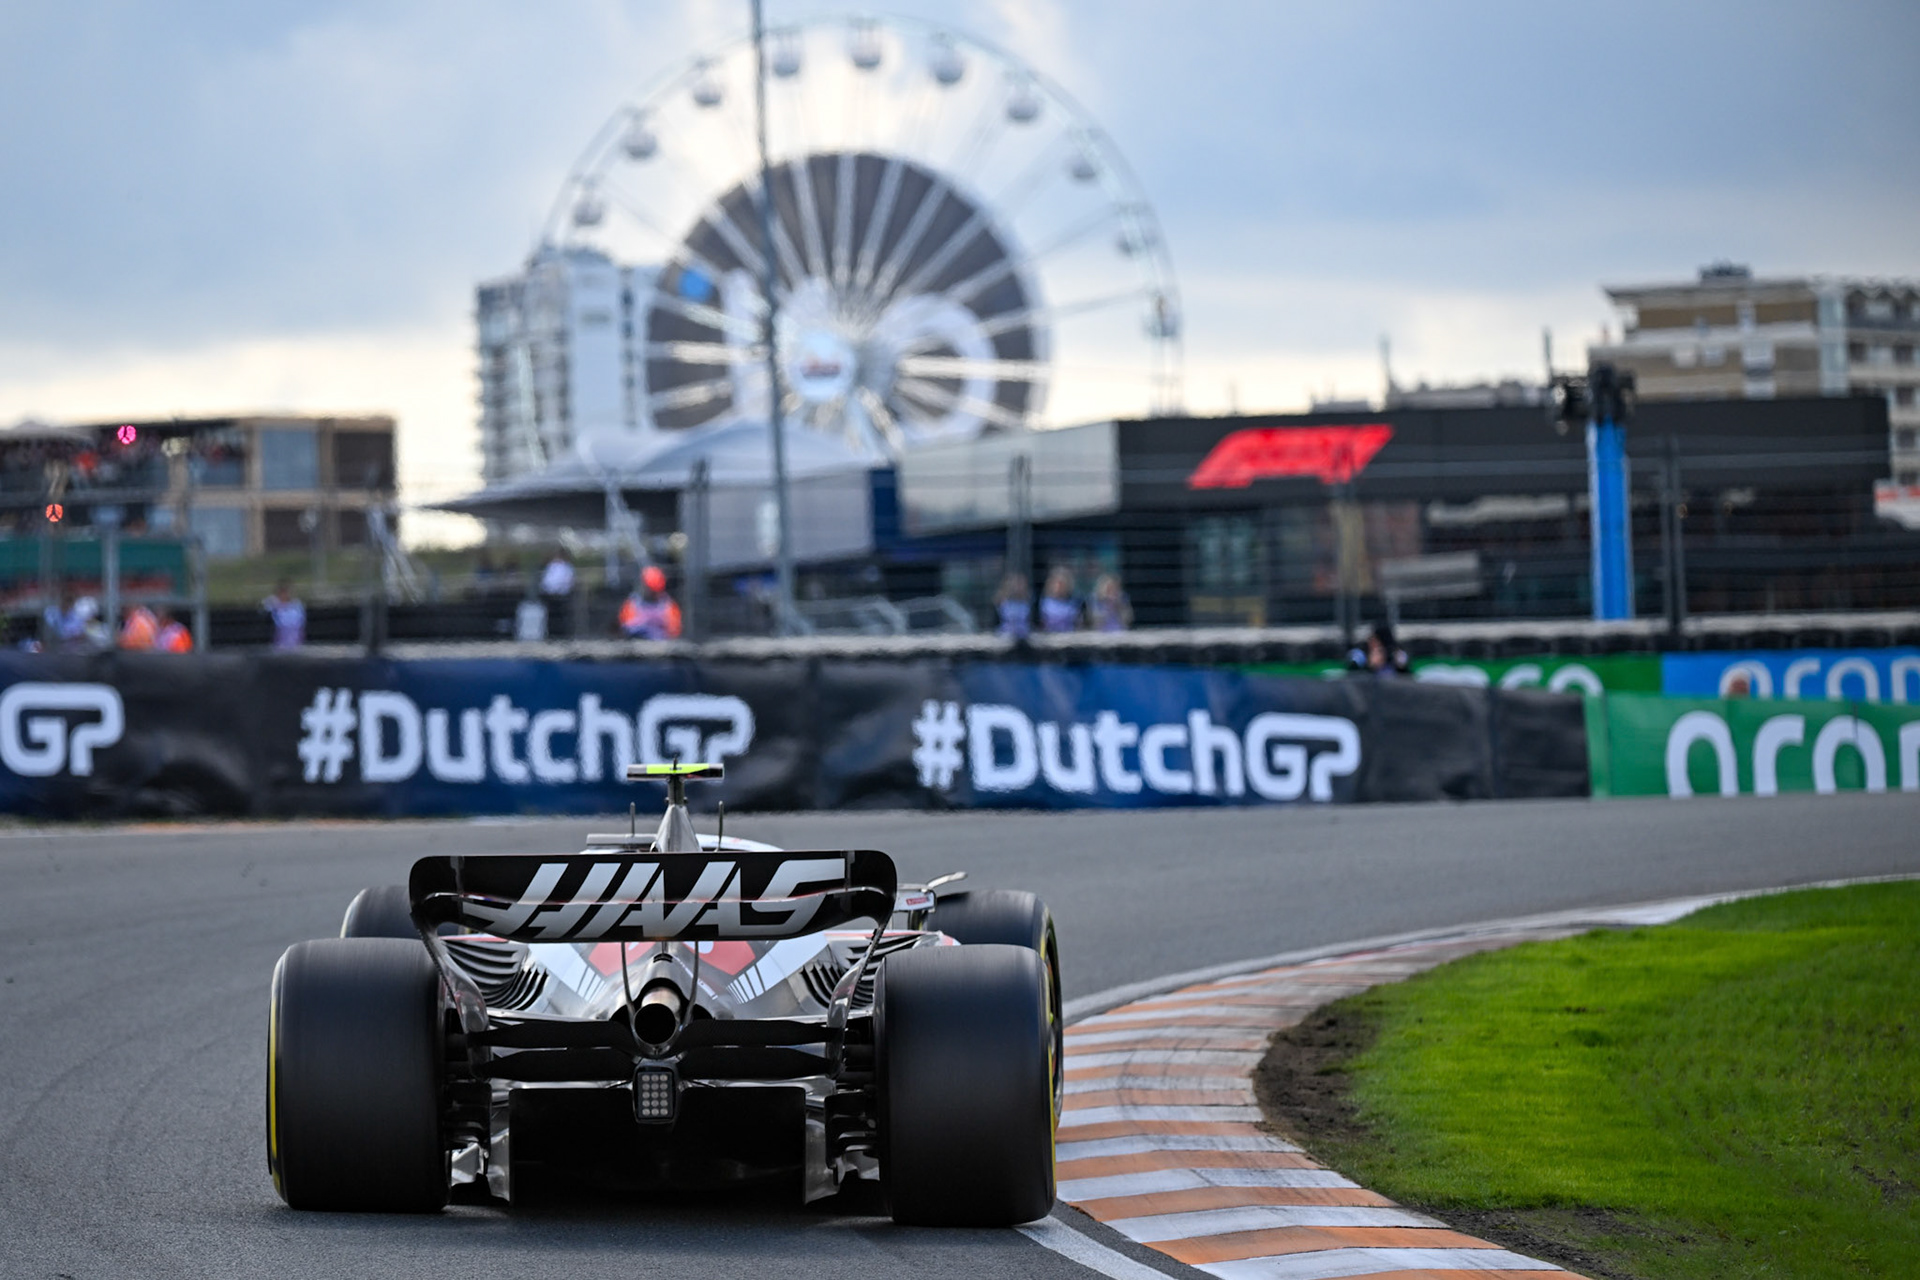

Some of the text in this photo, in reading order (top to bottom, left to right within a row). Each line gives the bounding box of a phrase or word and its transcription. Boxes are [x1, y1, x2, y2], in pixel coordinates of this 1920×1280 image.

[299, 687, 754, 783] #DutchGP
[913, 699, 1361, 800] #DutchGP
[463, 858, 846, 938] HAAS
